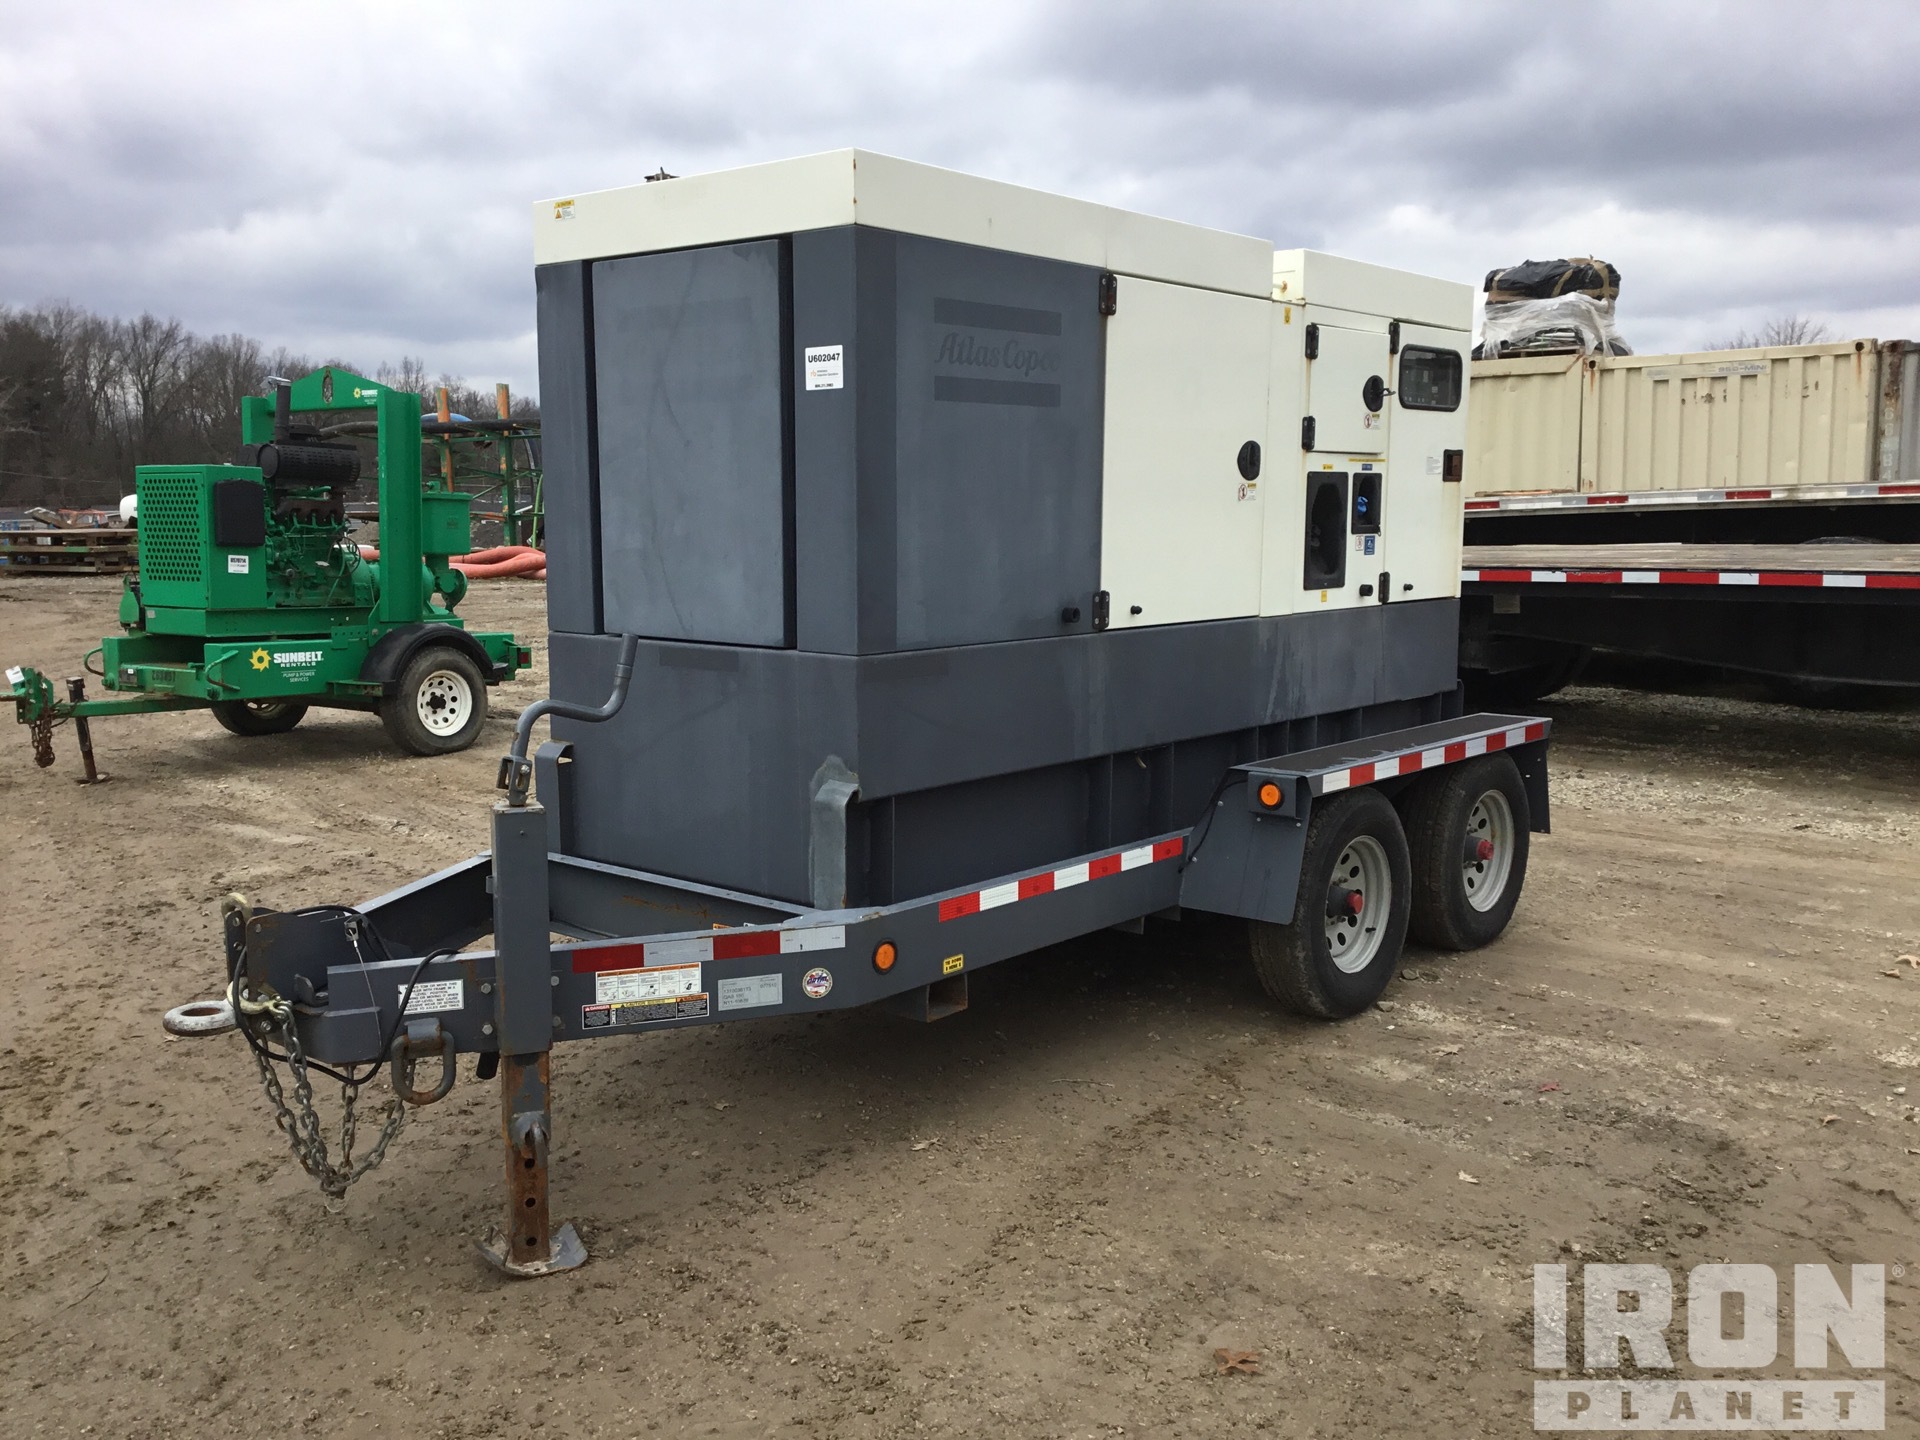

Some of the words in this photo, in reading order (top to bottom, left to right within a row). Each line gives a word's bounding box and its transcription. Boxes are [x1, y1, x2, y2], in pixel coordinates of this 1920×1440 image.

[934, 332, 1000, 368] Atlas
[808, 353, 840, 363] U602047
[274, 651, 322, 663] SUNBELT
